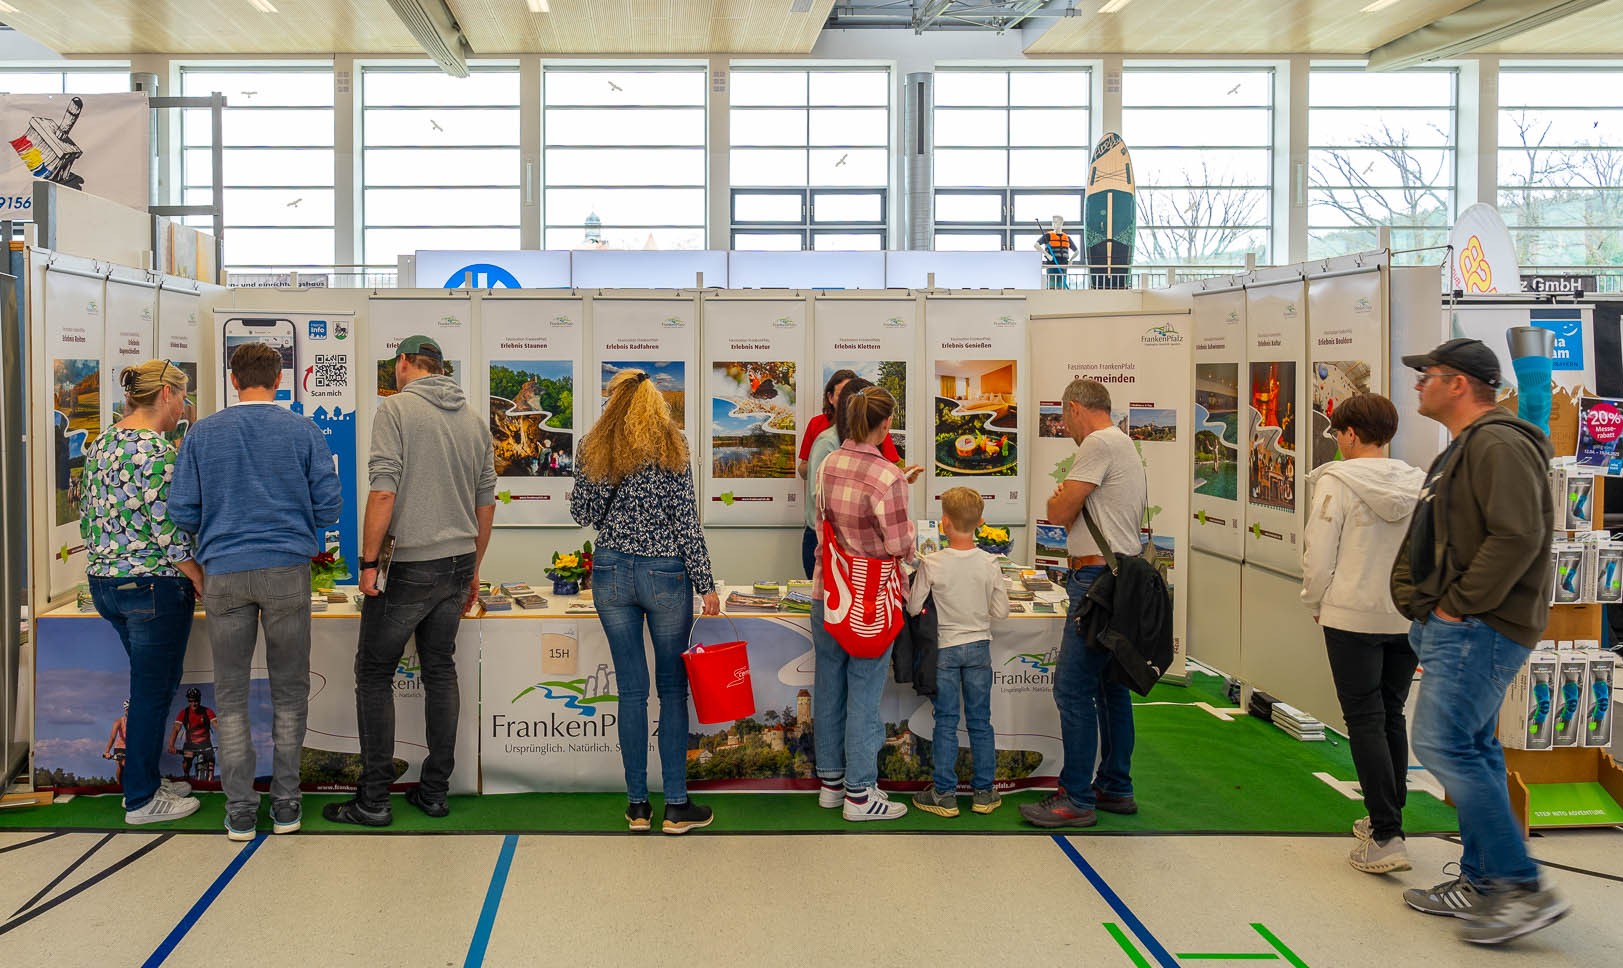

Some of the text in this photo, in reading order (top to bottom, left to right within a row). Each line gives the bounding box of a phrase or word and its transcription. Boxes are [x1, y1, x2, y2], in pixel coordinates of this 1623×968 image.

[1532, 277, 1582, 292] GmbH
[1141, 334, 1184, 343] FrankenPfalz
[1099, 362, 1136, 370] FrankenPfalz
[1590, 410, 1621, 425] 20%
[549, 648, 570, 659] 15H
[504, 743, 566, 756] Ursprünglich.
[568, 742, 612, 753] Natürlich.
